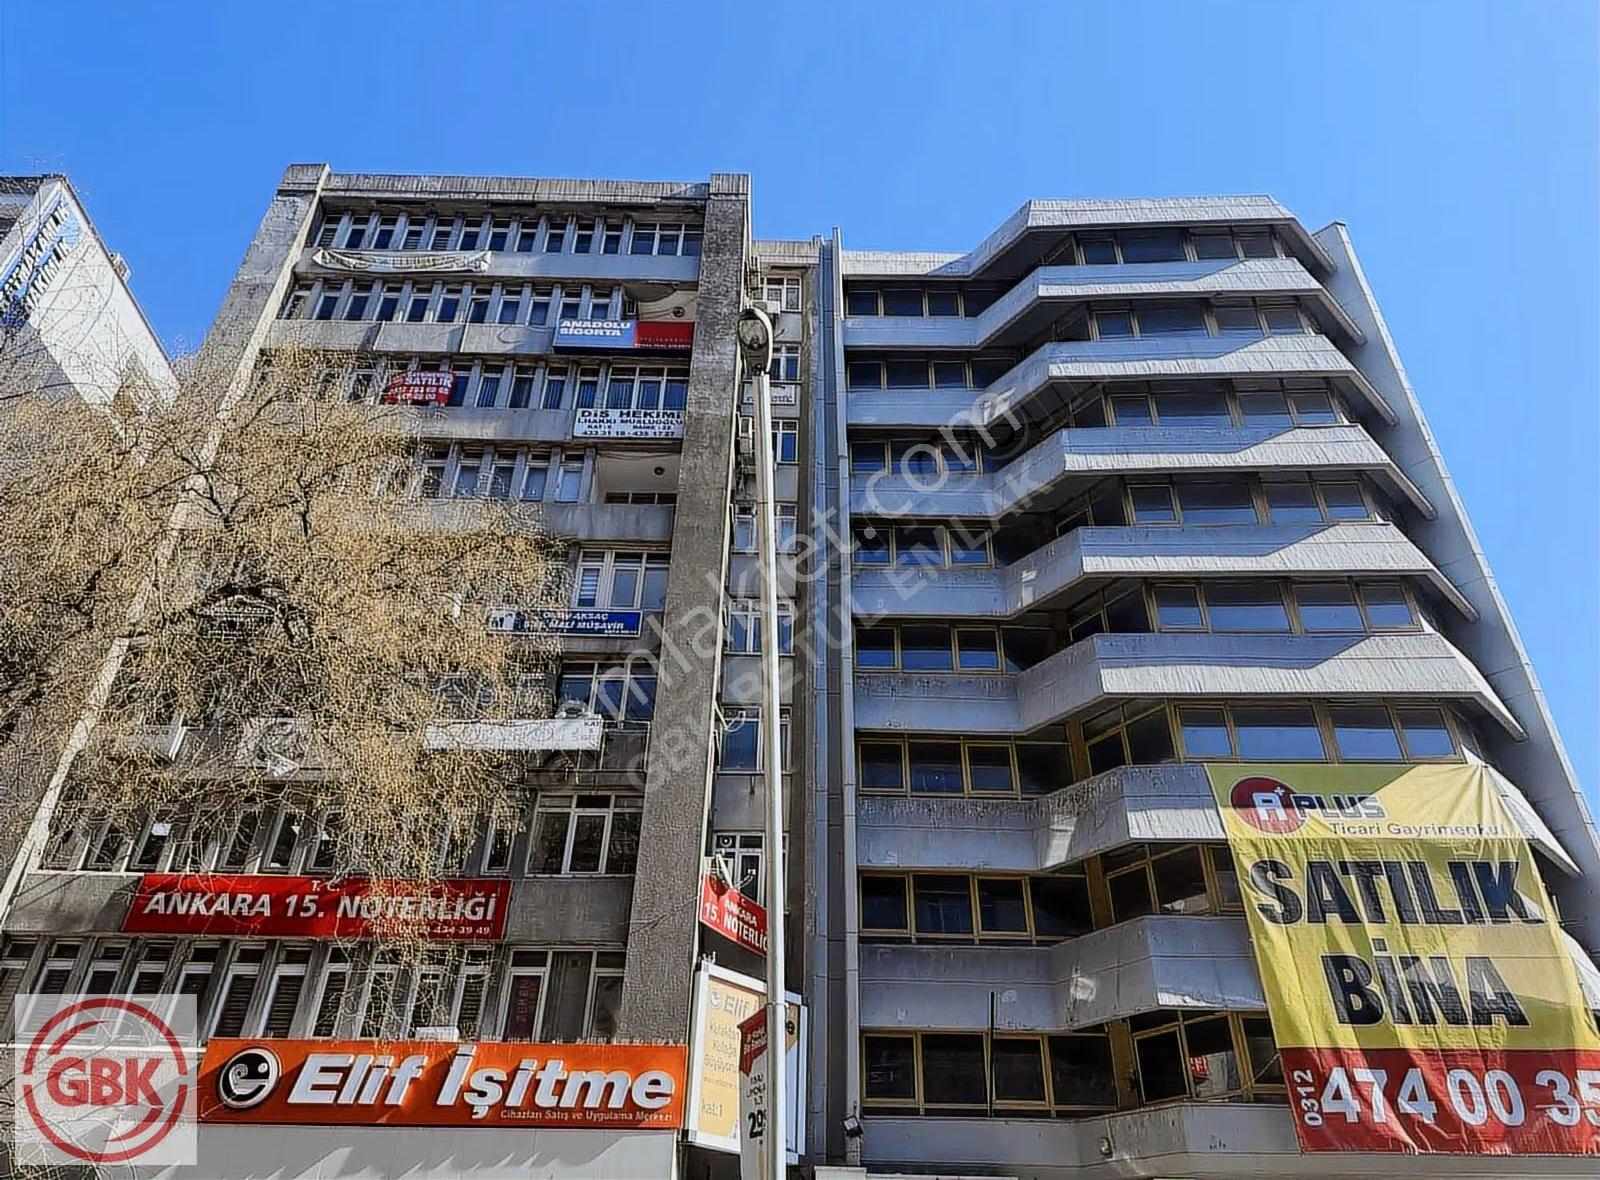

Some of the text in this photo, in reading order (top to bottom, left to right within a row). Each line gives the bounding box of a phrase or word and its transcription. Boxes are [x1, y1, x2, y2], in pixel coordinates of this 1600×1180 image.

[560, 319, 630, 328] ANADOLU
[1291, 793, 1388, 820] PLUS
[1330, 822, 1381, 835] Ticari
[143, 891, 497, 921] ANKARA 15. NOTERLİĞİ
[1249, 859, 1545, 926] SATILIK
[703, 902, 769, 953] 15. NOTERLİ
[724, 899, 757, 927] ANKARA
[1319, 937, 1530, 1028] BİNA
[287, 1053, 428, 1106] Elif
[437, 1043, 676, 1119] İşitme
[1293, 1069, 1324, 1127] 0312
[1320, 1066, 1438, 1125] 474
[1446, 1068, 1525, 1127] 00
